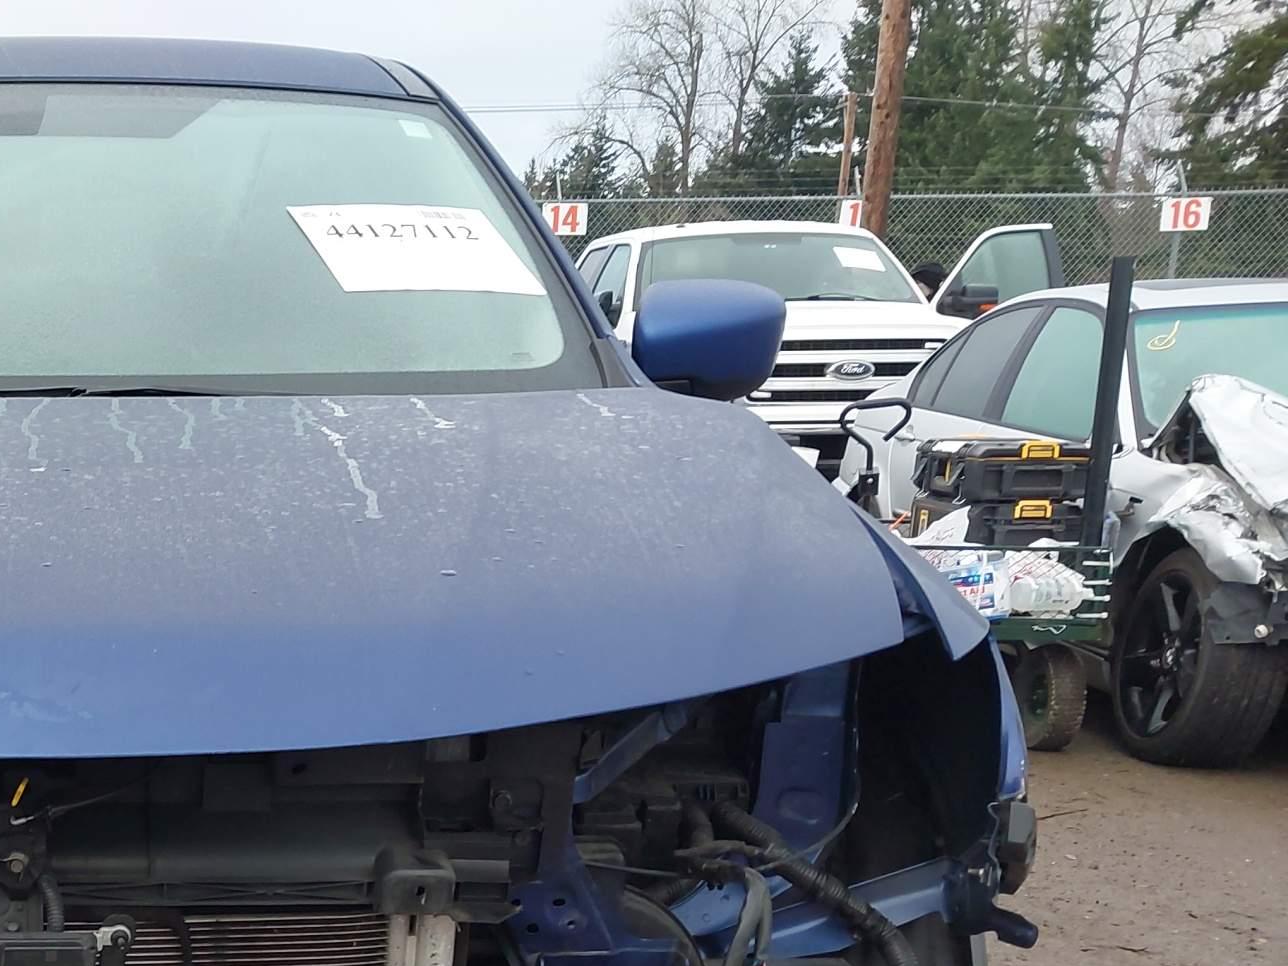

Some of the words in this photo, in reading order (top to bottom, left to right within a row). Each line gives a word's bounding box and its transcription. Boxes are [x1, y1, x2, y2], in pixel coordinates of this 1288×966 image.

[550, 205, 580, 233] 14
[1171, 198, 1201, 230] 16
[326, 223, 479, 241] 44127112
[840, 363, 866, 374] Ford
